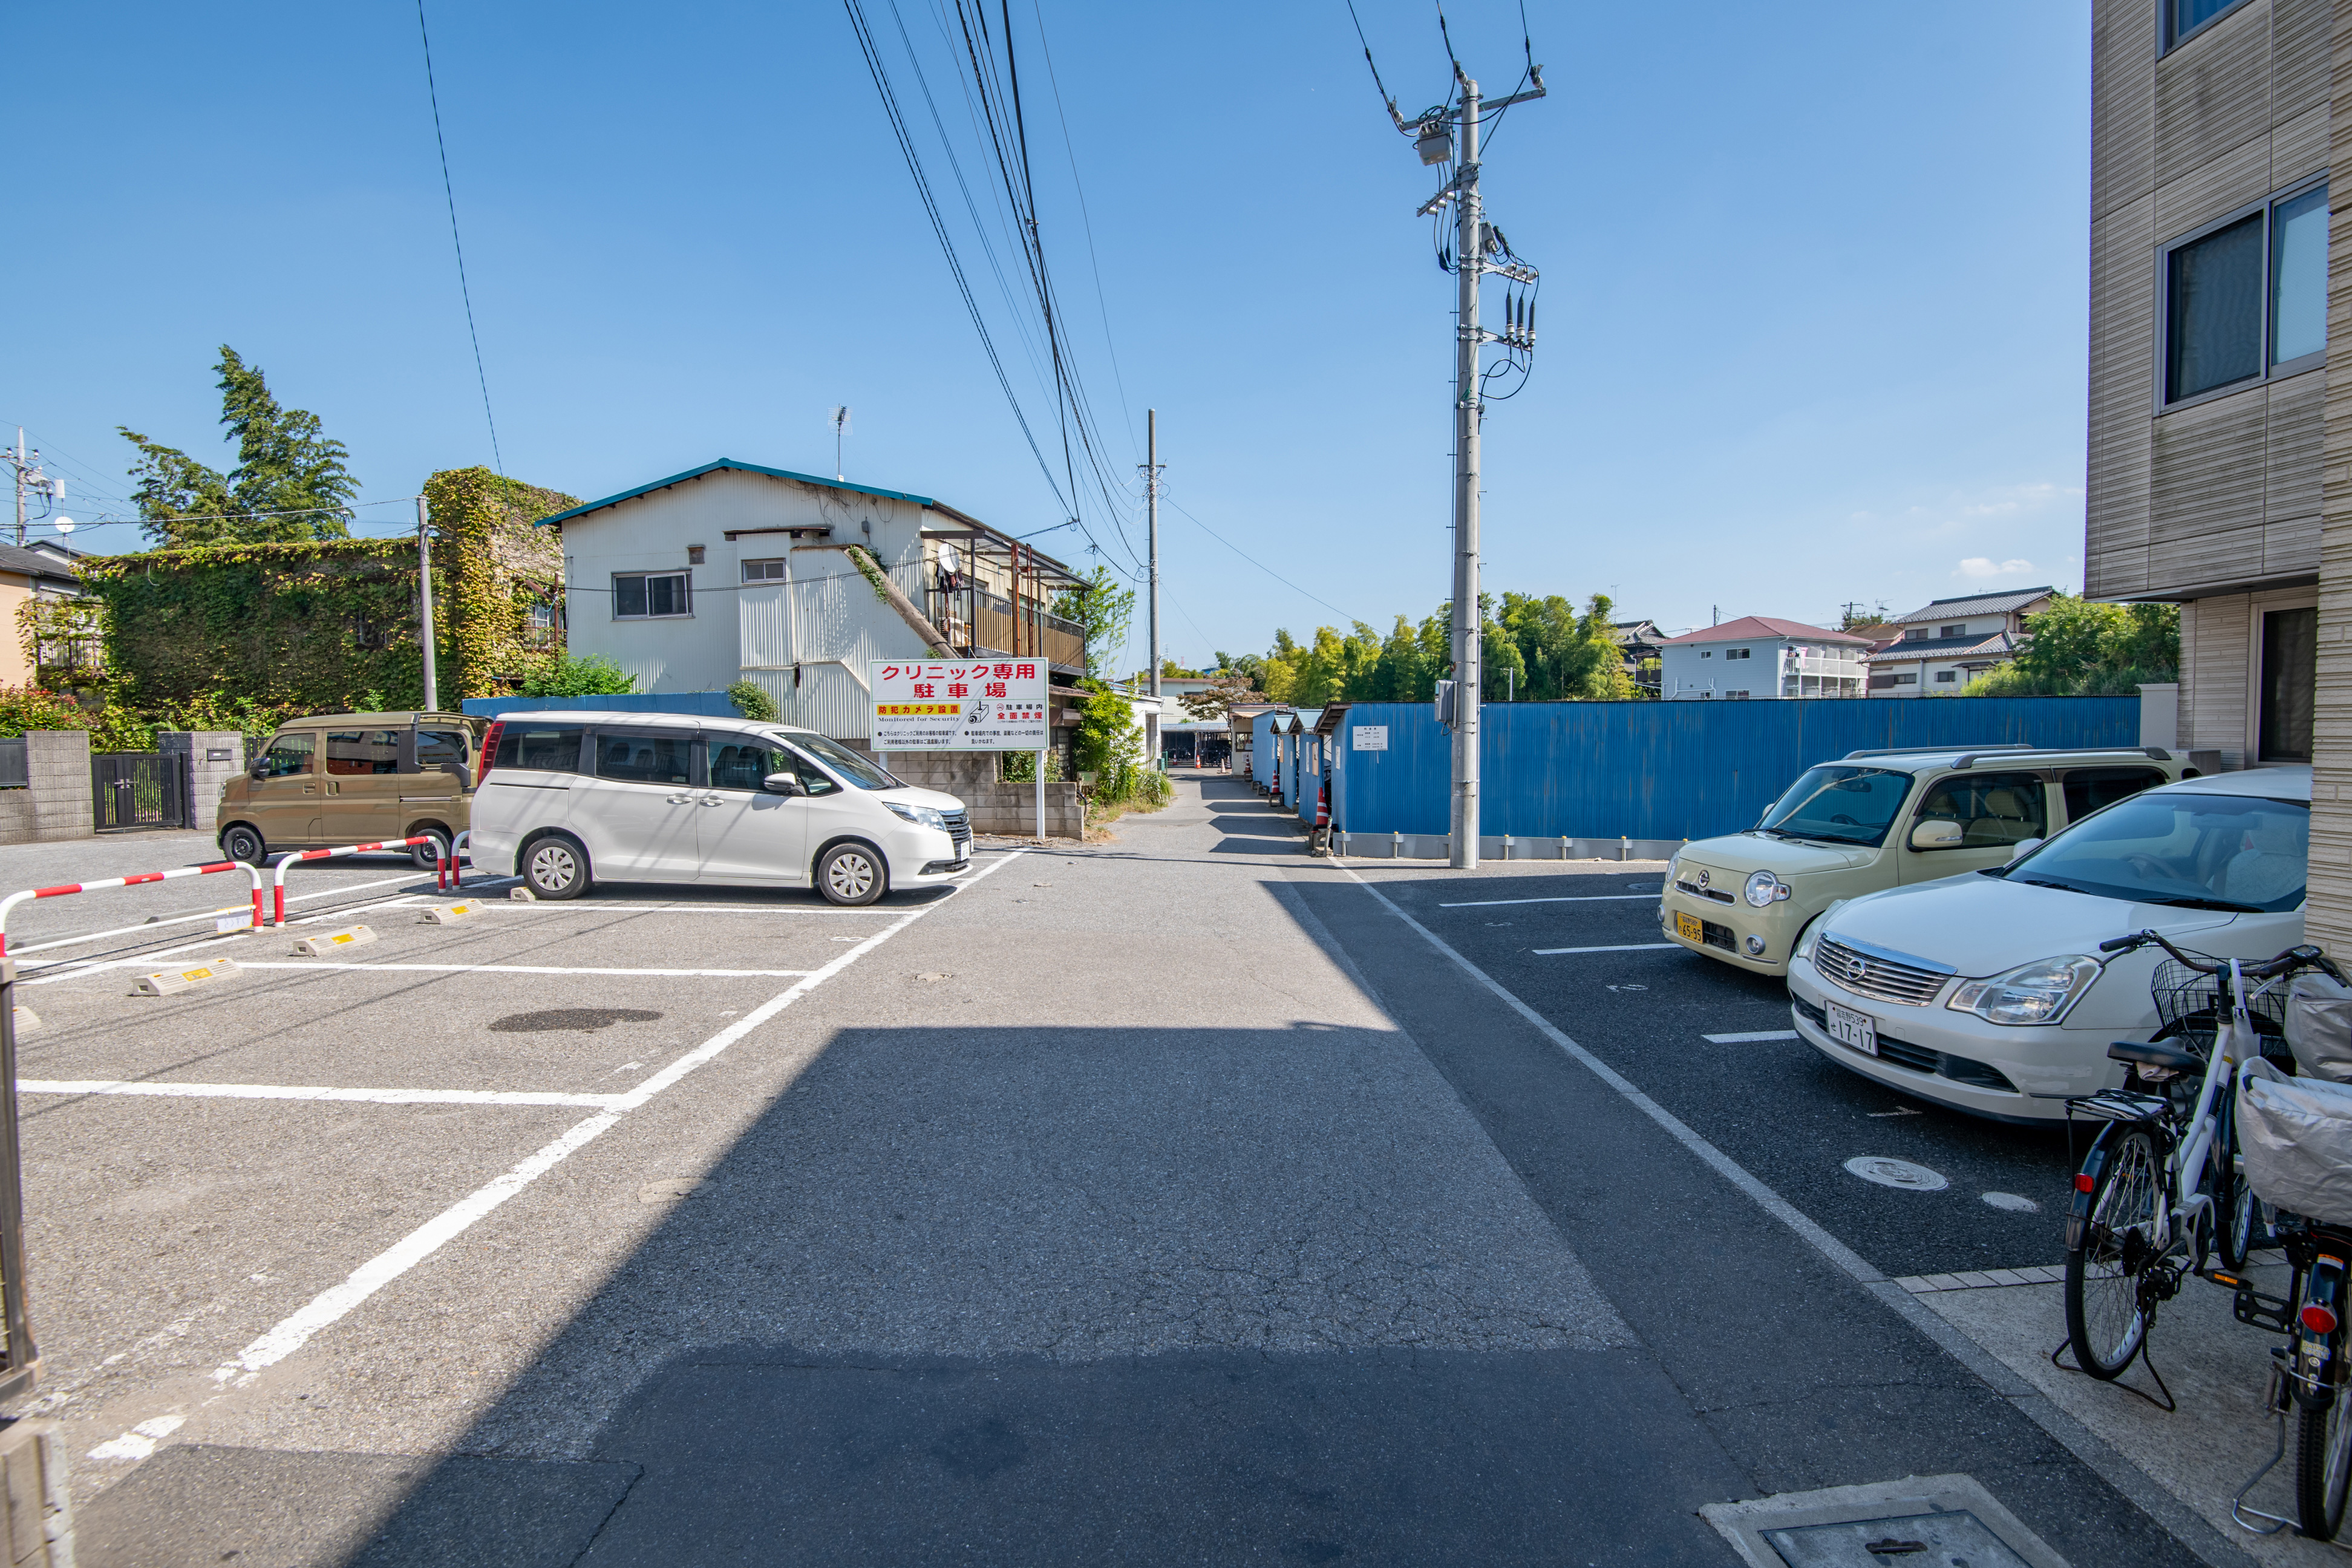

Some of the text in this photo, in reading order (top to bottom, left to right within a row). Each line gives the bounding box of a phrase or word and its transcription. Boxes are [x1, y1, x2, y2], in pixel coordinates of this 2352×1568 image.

[881, 663, 1035, 681] クリニック専用
[913, 682, 1007, 698] 駐車場
[878, 705, 958, 714] 防犯カメラ設置
[1683, 924, 1701, 941] 65-95
[1839, 1020, 1873, 1050] 17-17
